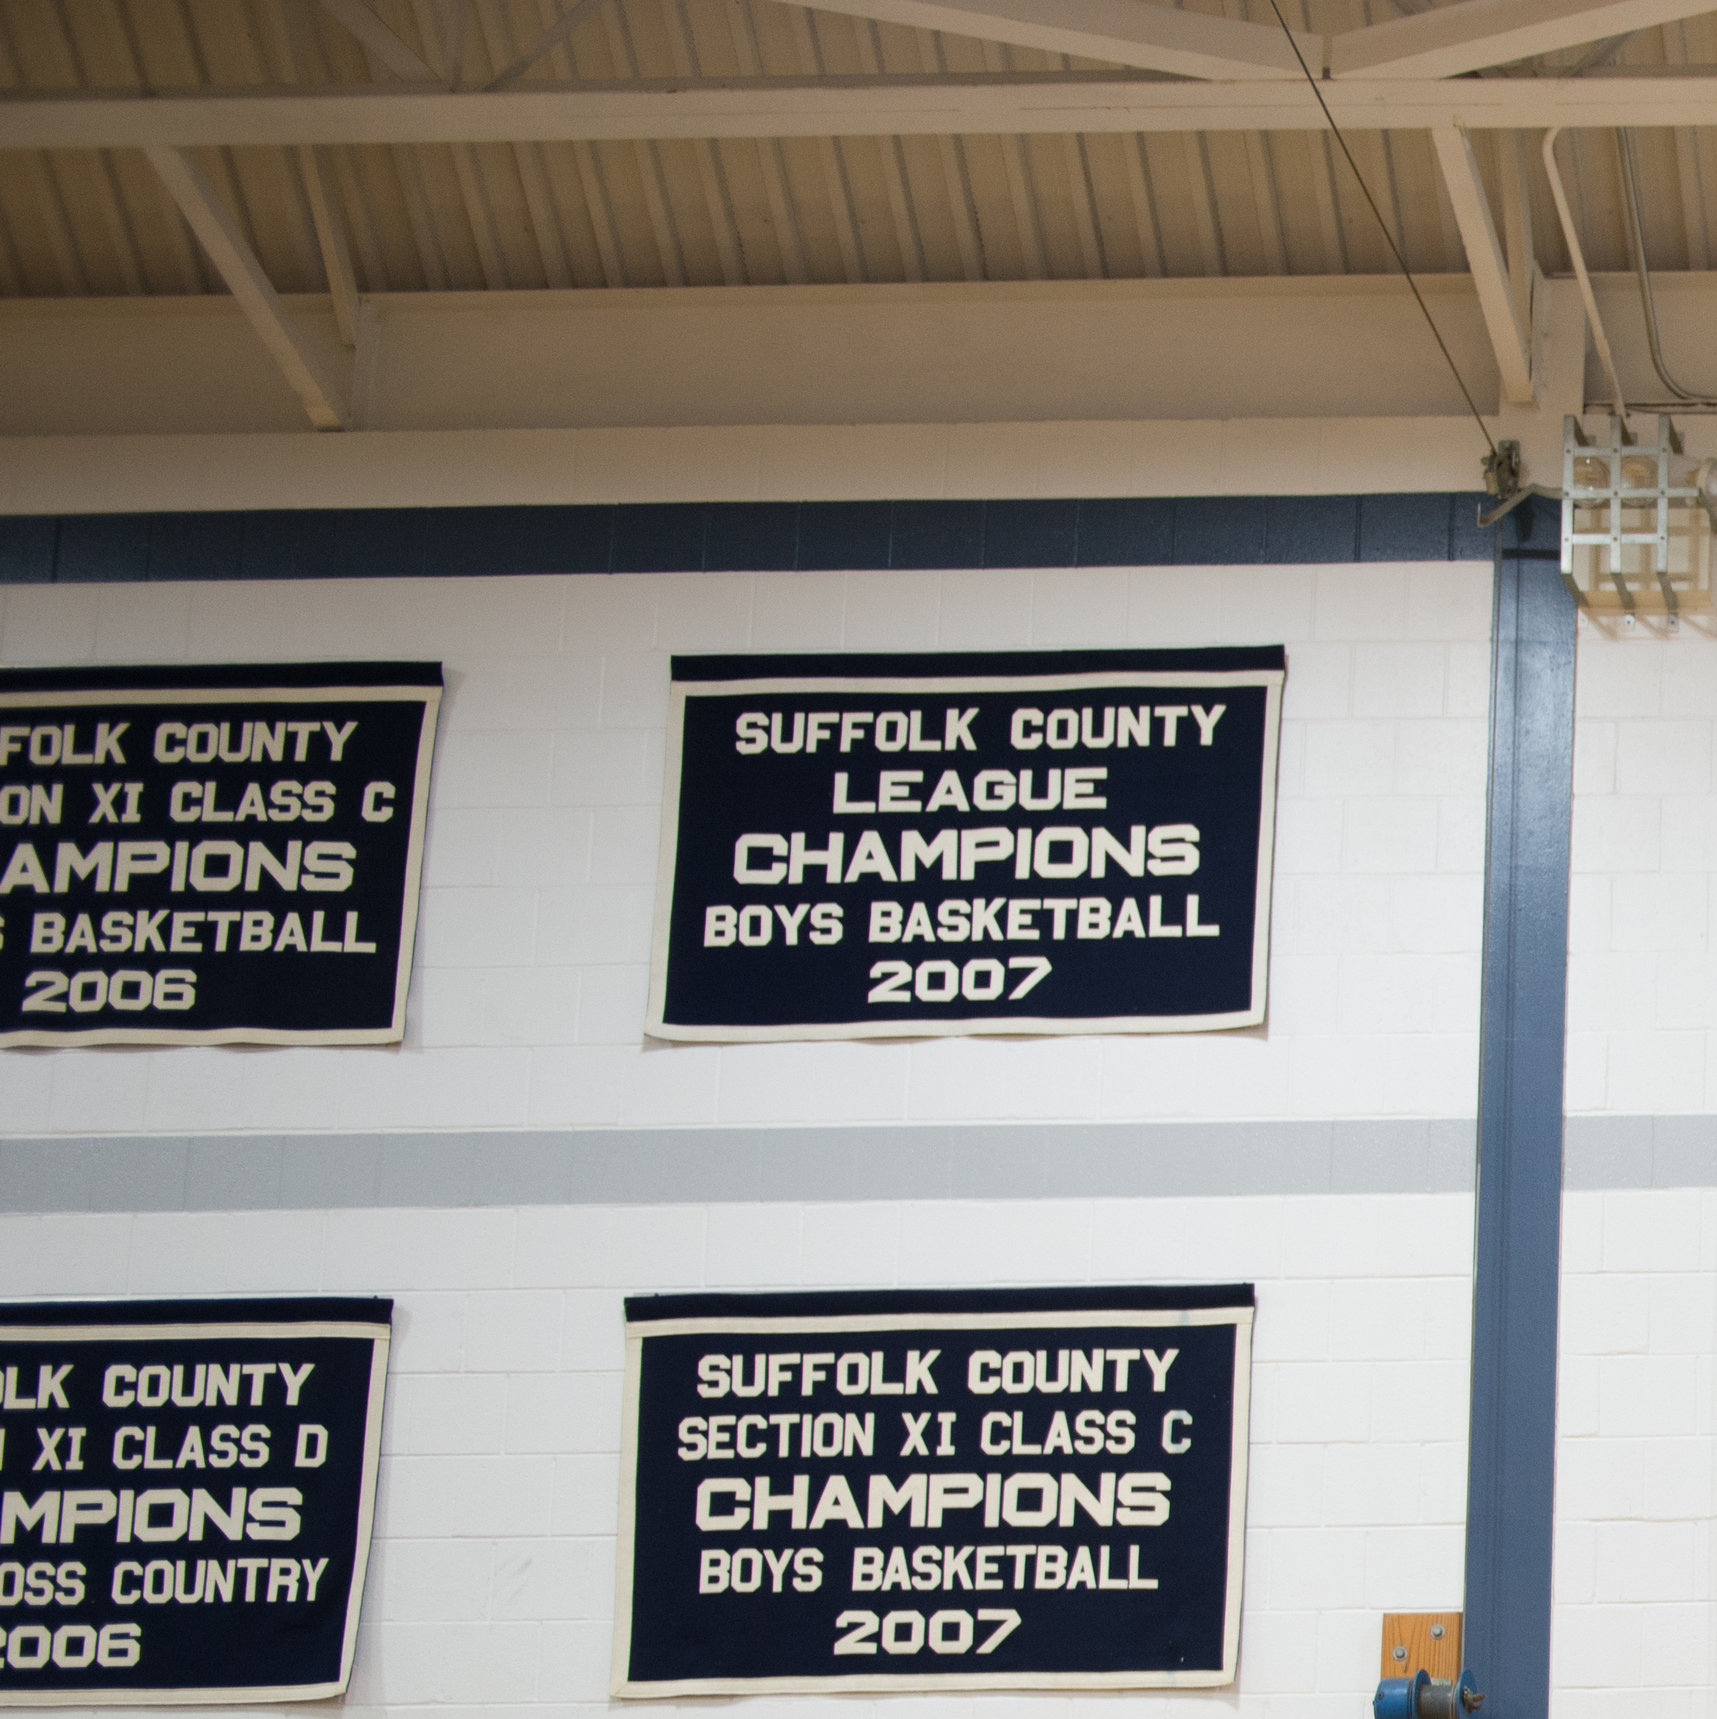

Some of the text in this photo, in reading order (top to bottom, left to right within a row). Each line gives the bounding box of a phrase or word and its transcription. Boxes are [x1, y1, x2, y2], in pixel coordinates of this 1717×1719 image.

[0, 722, 358, 765] FOLK COUNTY
[736, 705, 1226, 754] SUFFOLK COUNTY
[0, 781, 395, 824] ON XI CLASS C
[833, 767, 1107, 813] LEAGUE
[0, 841, 356, 893] AMPIONS
[734, 824, 1199, 884] CHAMPIONS
[31, 910, 376, 953] BASKETBALL
[704, 895, 1219, 947] BOYS BASKETBALL
[22, 969, 197, 1012] 2006
[868, 957, 1052, 1003] 2007
[0, 1363, 315, 1408] LK COUNTY
[697, 1349, 1179, 1398] SUFFOLK COUNTY
[33, 1428, 86, 1470] XI
[113, 1424, 271, 1469] CLASS
[295, 1424, 328, 1467] D
[678, 1410, 1192, 1460] SECTION XI CLASS C
[0, 1487, 302, 1544] MPIONS
[696, 1473, 1171, 1531] CHAMPIONS
[0, 1558, 329, 1605] OSS COUNTRY
[699, 1545, 1158, 1593] BOYS BASKETBALL
[0, 1623, 142, 1669] 006
[834, 1609, 1021, 1655] 2007
